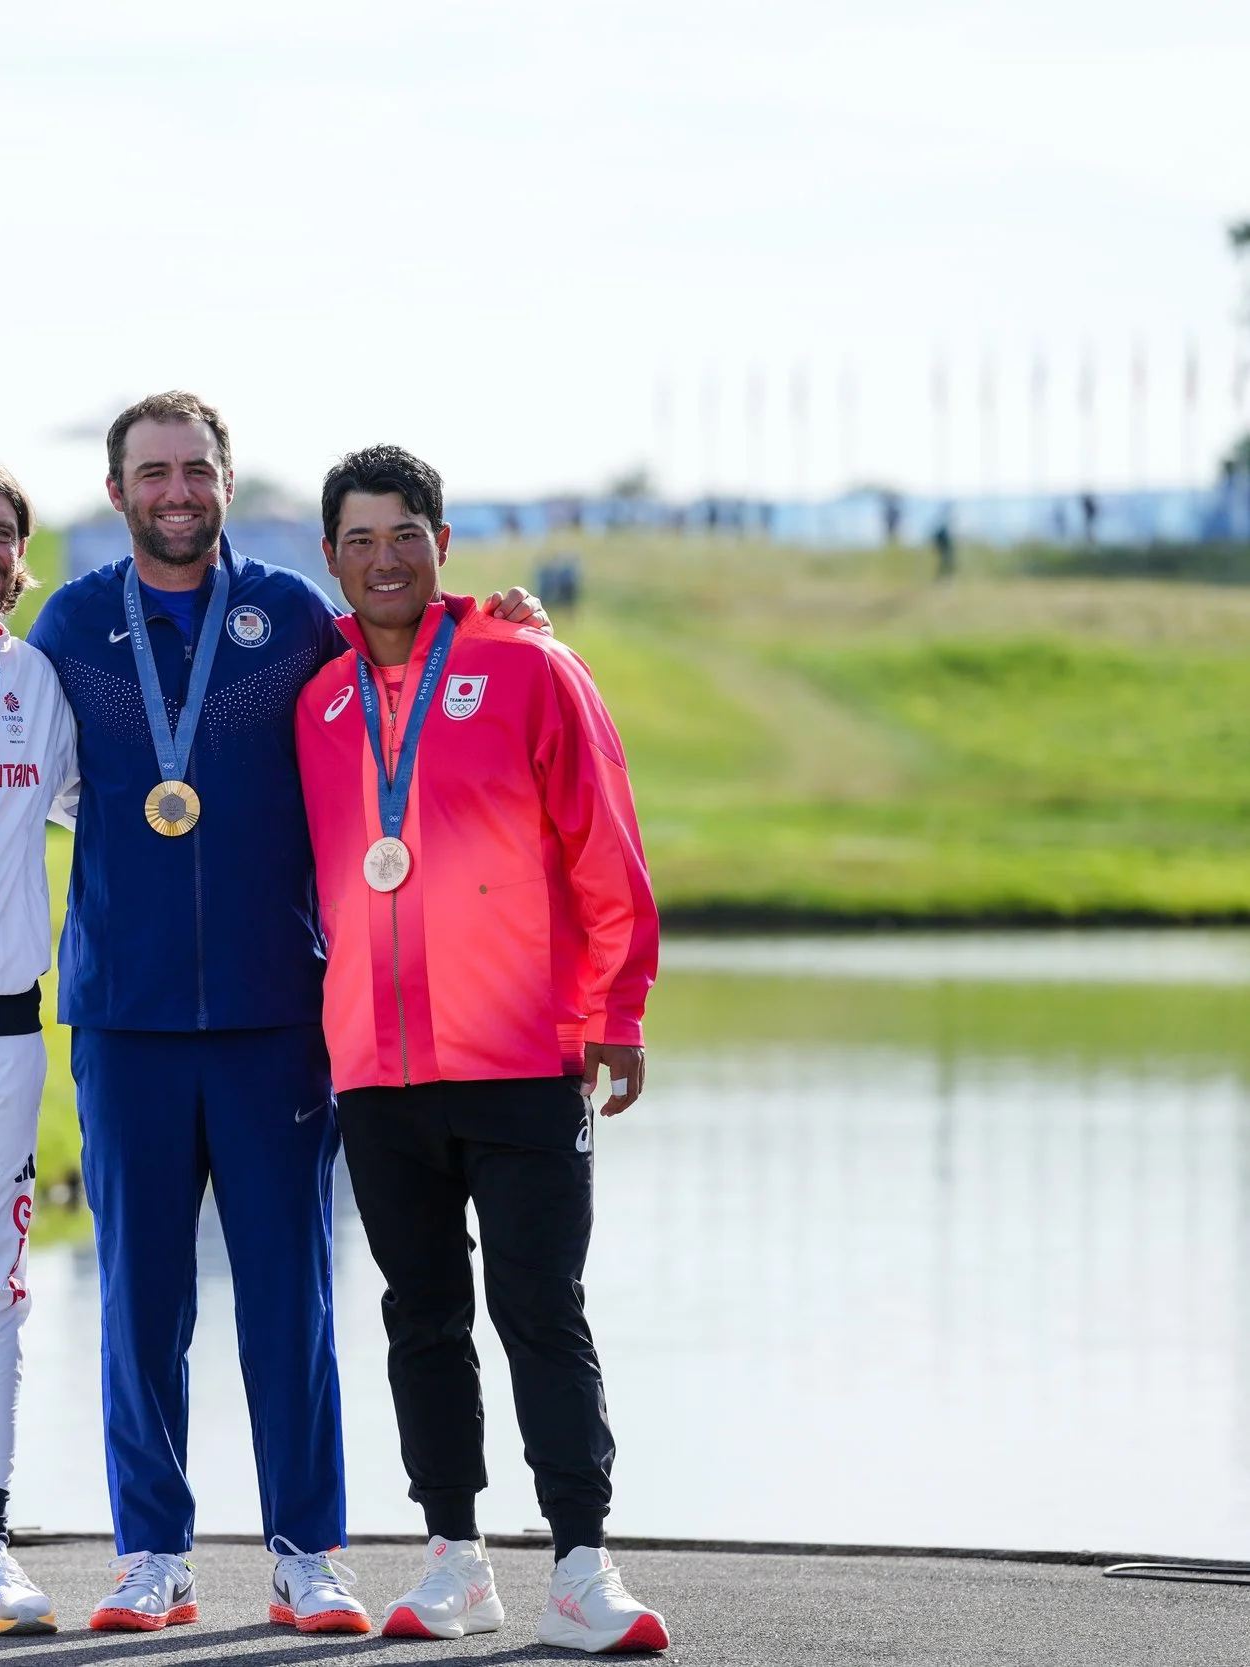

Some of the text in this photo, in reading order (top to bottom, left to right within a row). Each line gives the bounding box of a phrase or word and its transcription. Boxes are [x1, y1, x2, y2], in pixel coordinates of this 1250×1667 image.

[127, 592, 143, 650] PARIS 2024
[362, 685, 373, 713] PARIS
[418, 646, 443, 700] PARIS 2024
